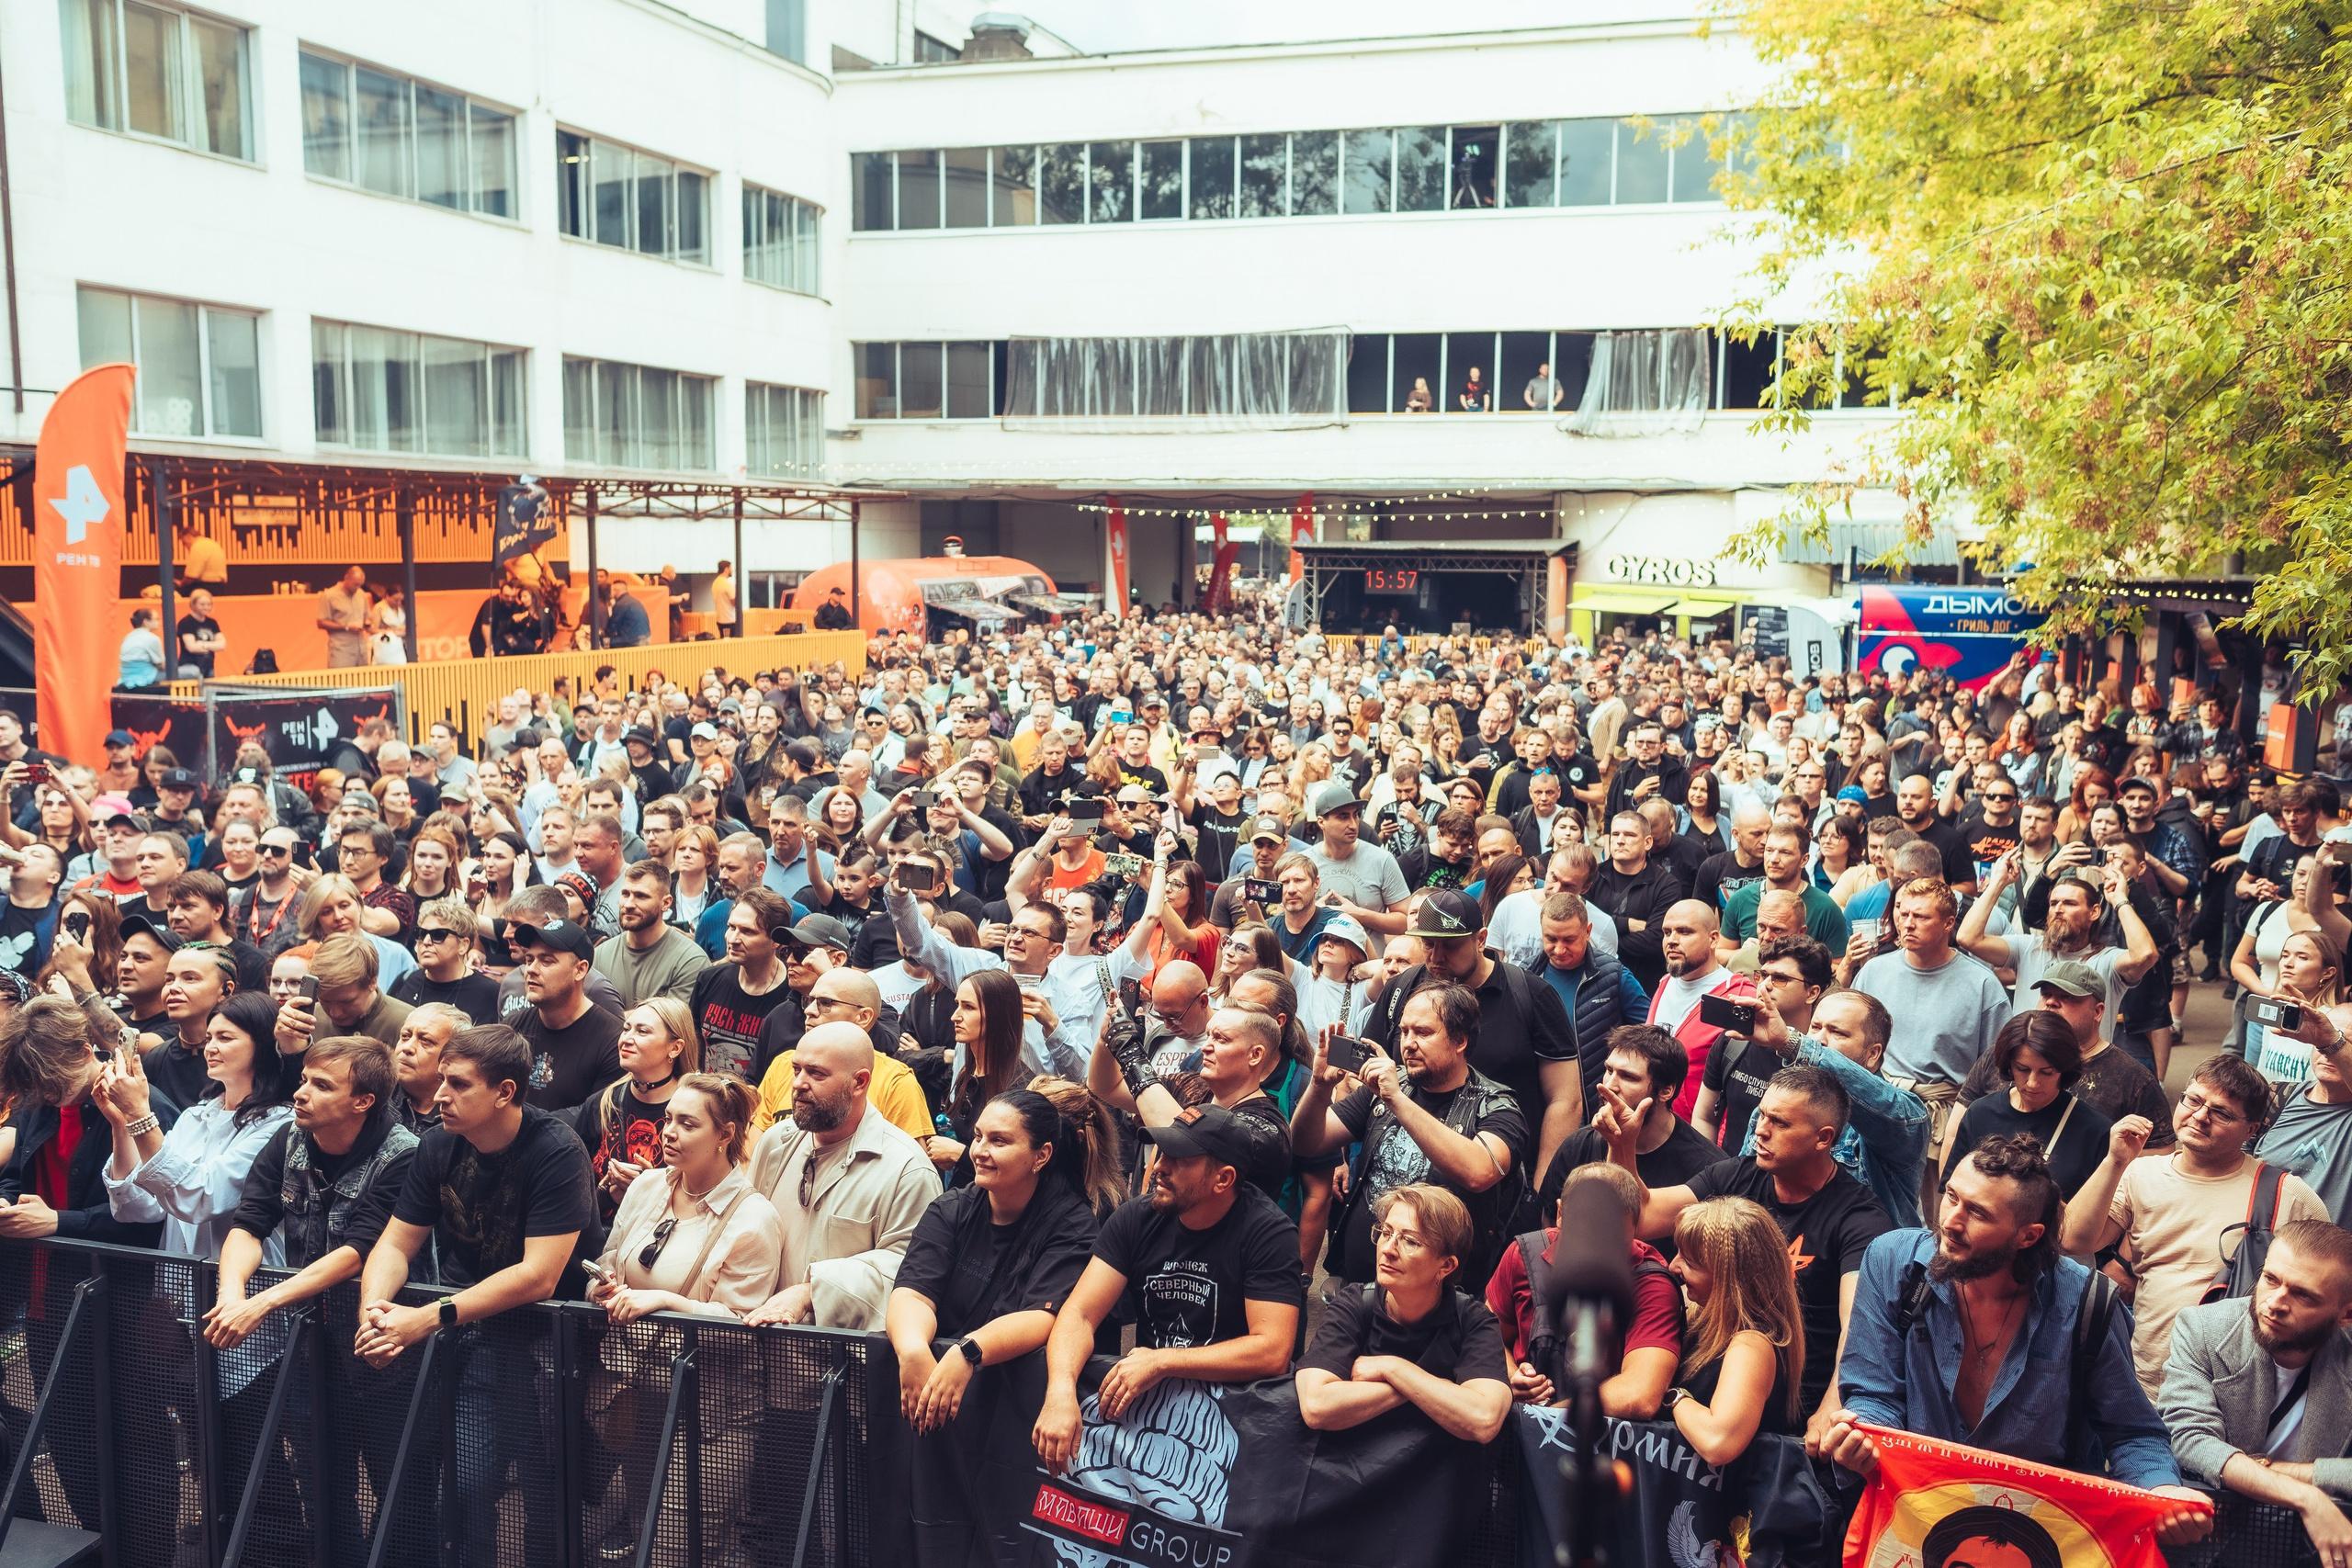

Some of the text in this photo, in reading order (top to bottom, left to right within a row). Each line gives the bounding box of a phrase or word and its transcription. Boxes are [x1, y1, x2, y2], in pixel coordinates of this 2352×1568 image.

[56, 552, 100, 568] РЕН ТВ
[1365, 570, 1418, 589] 15:57
[1604, 554, 1717, 588] GYROS
[1957, 618, 2012, 633] ГРИЛЬ ДОГ
[282, 720, 306, 735] РЕН
[289, 733, 306, 746] ТВ
[704, 1003, 735, 1031] РУСЬ
[1747, 1076, 1769, 1090] СЛУШ
[1745, 1085, 1764, 1099] ЛИБО
[1149, 1279, 1210, 1298] СЕВЕРНЫЙ
[1911, 1280, 1925, 1303] Reebok
[1156, 1291, 1205, 1307] ЧЕЛОВЕК
[1038, 1490, 1125, 1540] МАВАШИ
[1130, 1521, 1231, 1568] GROUP
